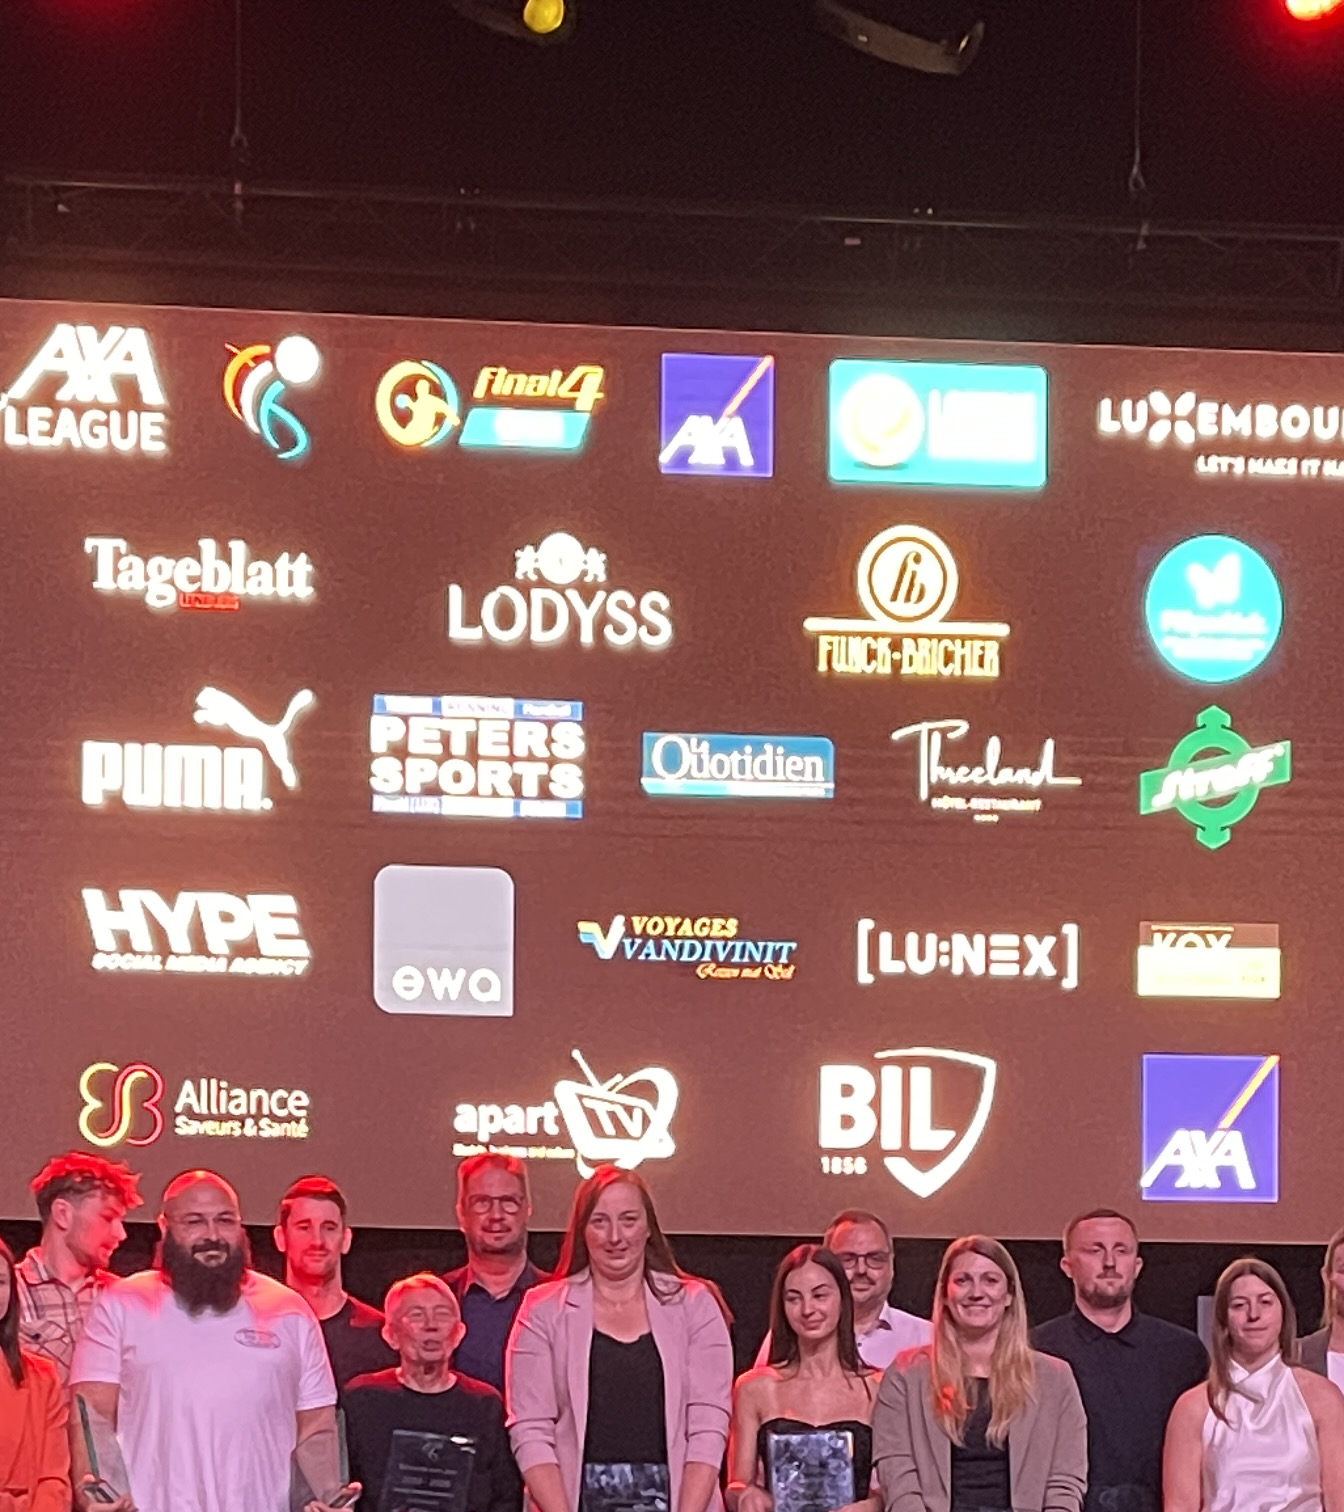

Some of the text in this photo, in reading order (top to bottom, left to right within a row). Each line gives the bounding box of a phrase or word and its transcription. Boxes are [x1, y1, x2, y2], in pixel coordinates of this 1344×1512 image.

[6, 323, 166, 405] AXA
[4, 405, 167, 451] LEAGUE
[659, 414, 754, 466] AXA
[85, 537, 315, 609] Tageblatt
[448, 584, 673, 647] LODYSS
[370, 715, 585, 760] PETERS
[651, 735, 825, 782] Quotidien
[82, 740, 264, 809] PUMA
[369, 756, 585, 799] SPORTS
[81, 888, 310, 959] HYPE
[630, 916, 739, 938] VOYAGES
[622, 938, 798, 964] VANDIVINIT
[392, 965, 502, 1003] ewa
[174, 1078, 310, 1117] Alliance
[454, 1097, 644, 1142] apart TV
[819, 1064, 957, 1151] BIL
[174, 1115, 242, 1136] Saveurs
[258, 1117, 309, 1138] Santé
[1141, 1128, 1257, 1189] AXA
